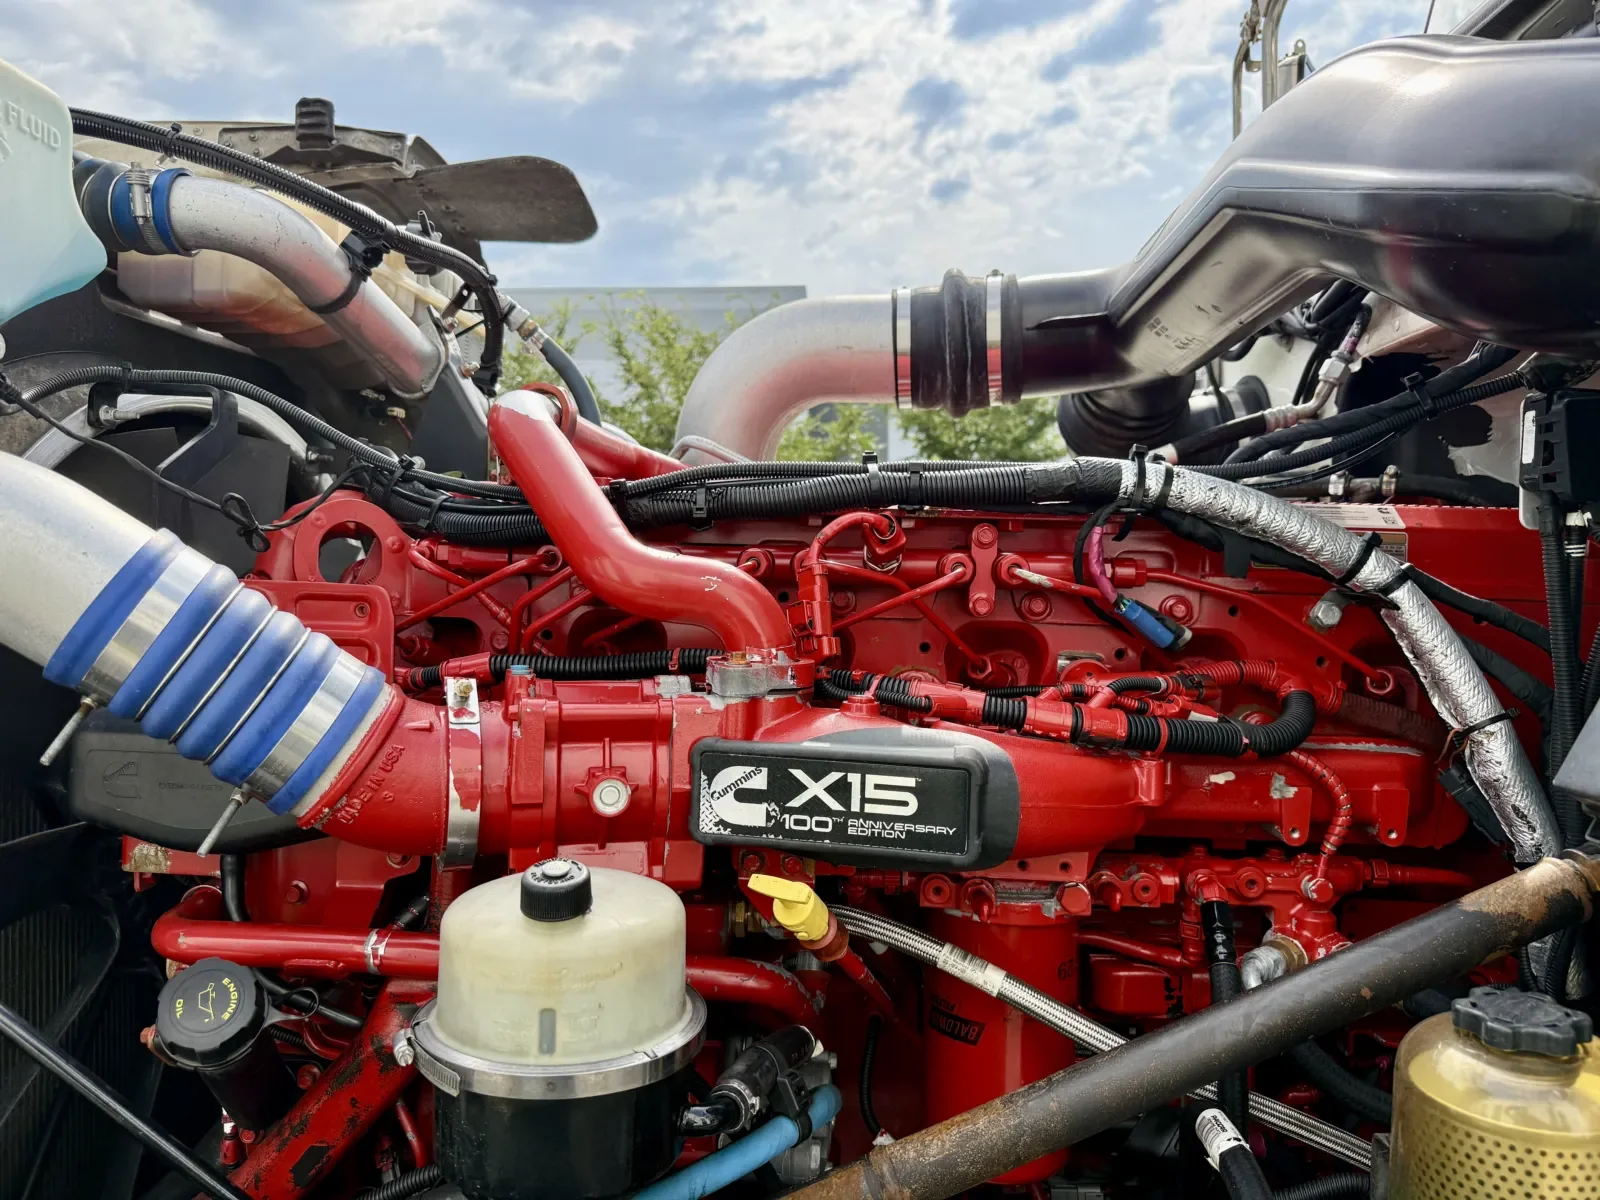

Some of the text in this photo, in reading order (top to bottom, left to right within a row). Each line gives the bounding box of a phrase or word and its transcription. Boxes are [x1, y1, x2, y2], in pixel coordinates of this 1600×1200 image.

[6, 101, 61, 148] FLUID
[367, 773, 386, 792] IN
[379, 744, 406, 773] USA
[711, 766, 763, 802] Cummins
[785, 768, 918, 816] X15
[848, 818, 957, 836] ANNIVERSARY
[848, 827, 906, 840] EDITION
[176, 999, 184, 1019] OIL
[221, 977, 238, 1021] ENGINE
